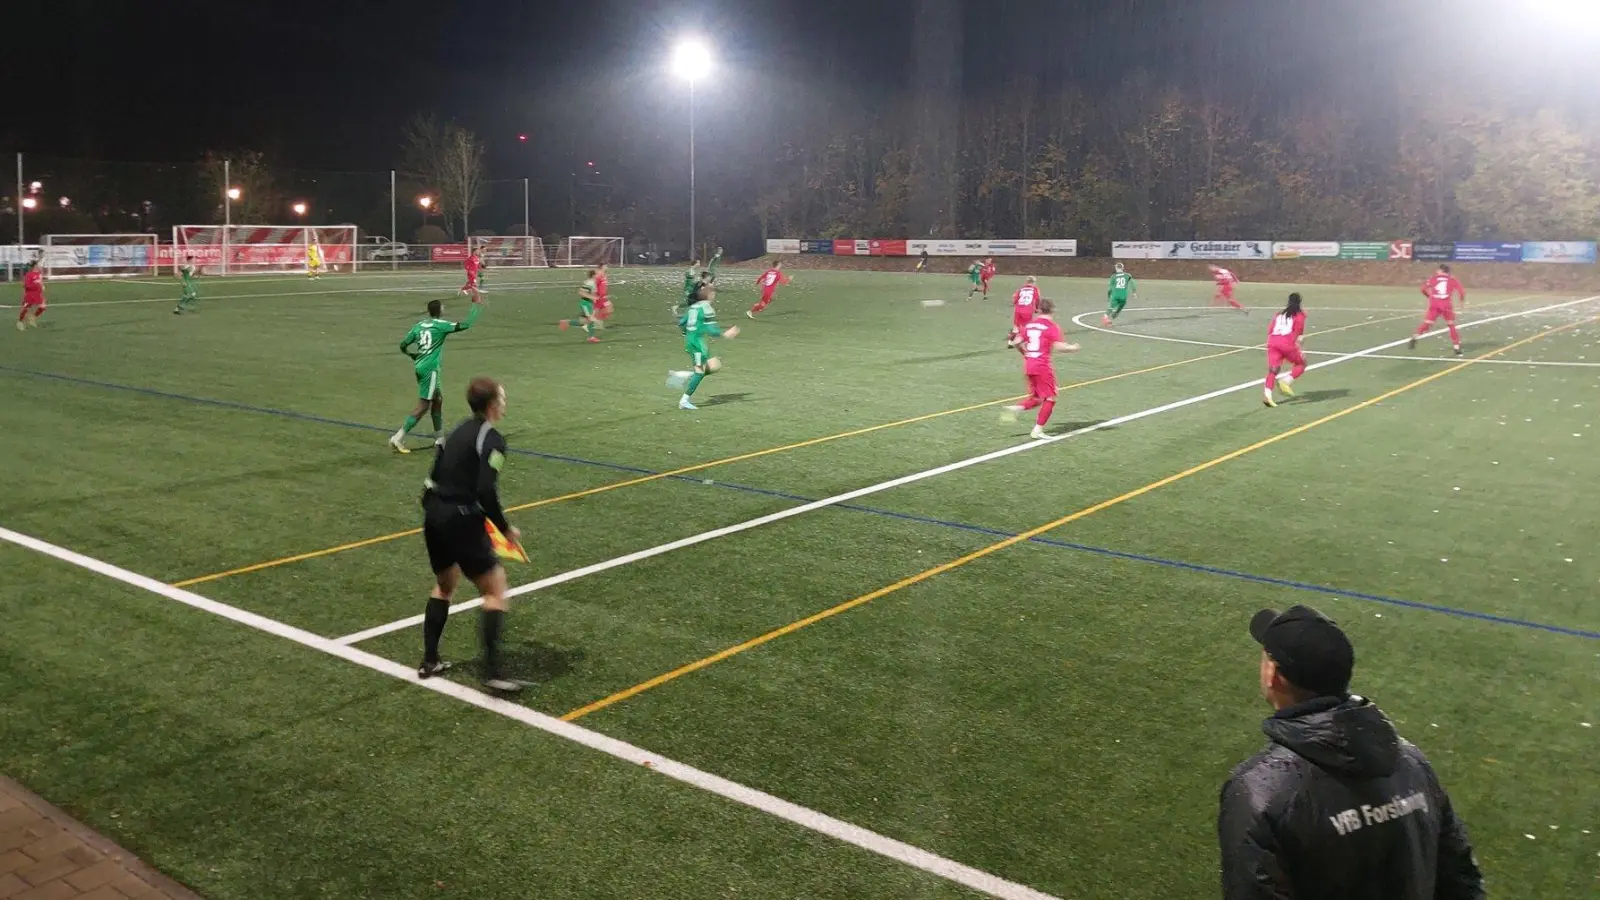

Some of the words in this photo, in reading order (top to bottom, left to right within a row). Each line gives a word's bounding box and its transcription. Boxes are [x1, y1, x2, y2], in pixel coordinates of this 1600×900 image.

[1115, 277, 1126, 289] 20
[1434, 281, 1448, 295] 4
[1018, 290, 1034, 306] 25
[1329, 809, 1361, 835] VfB
